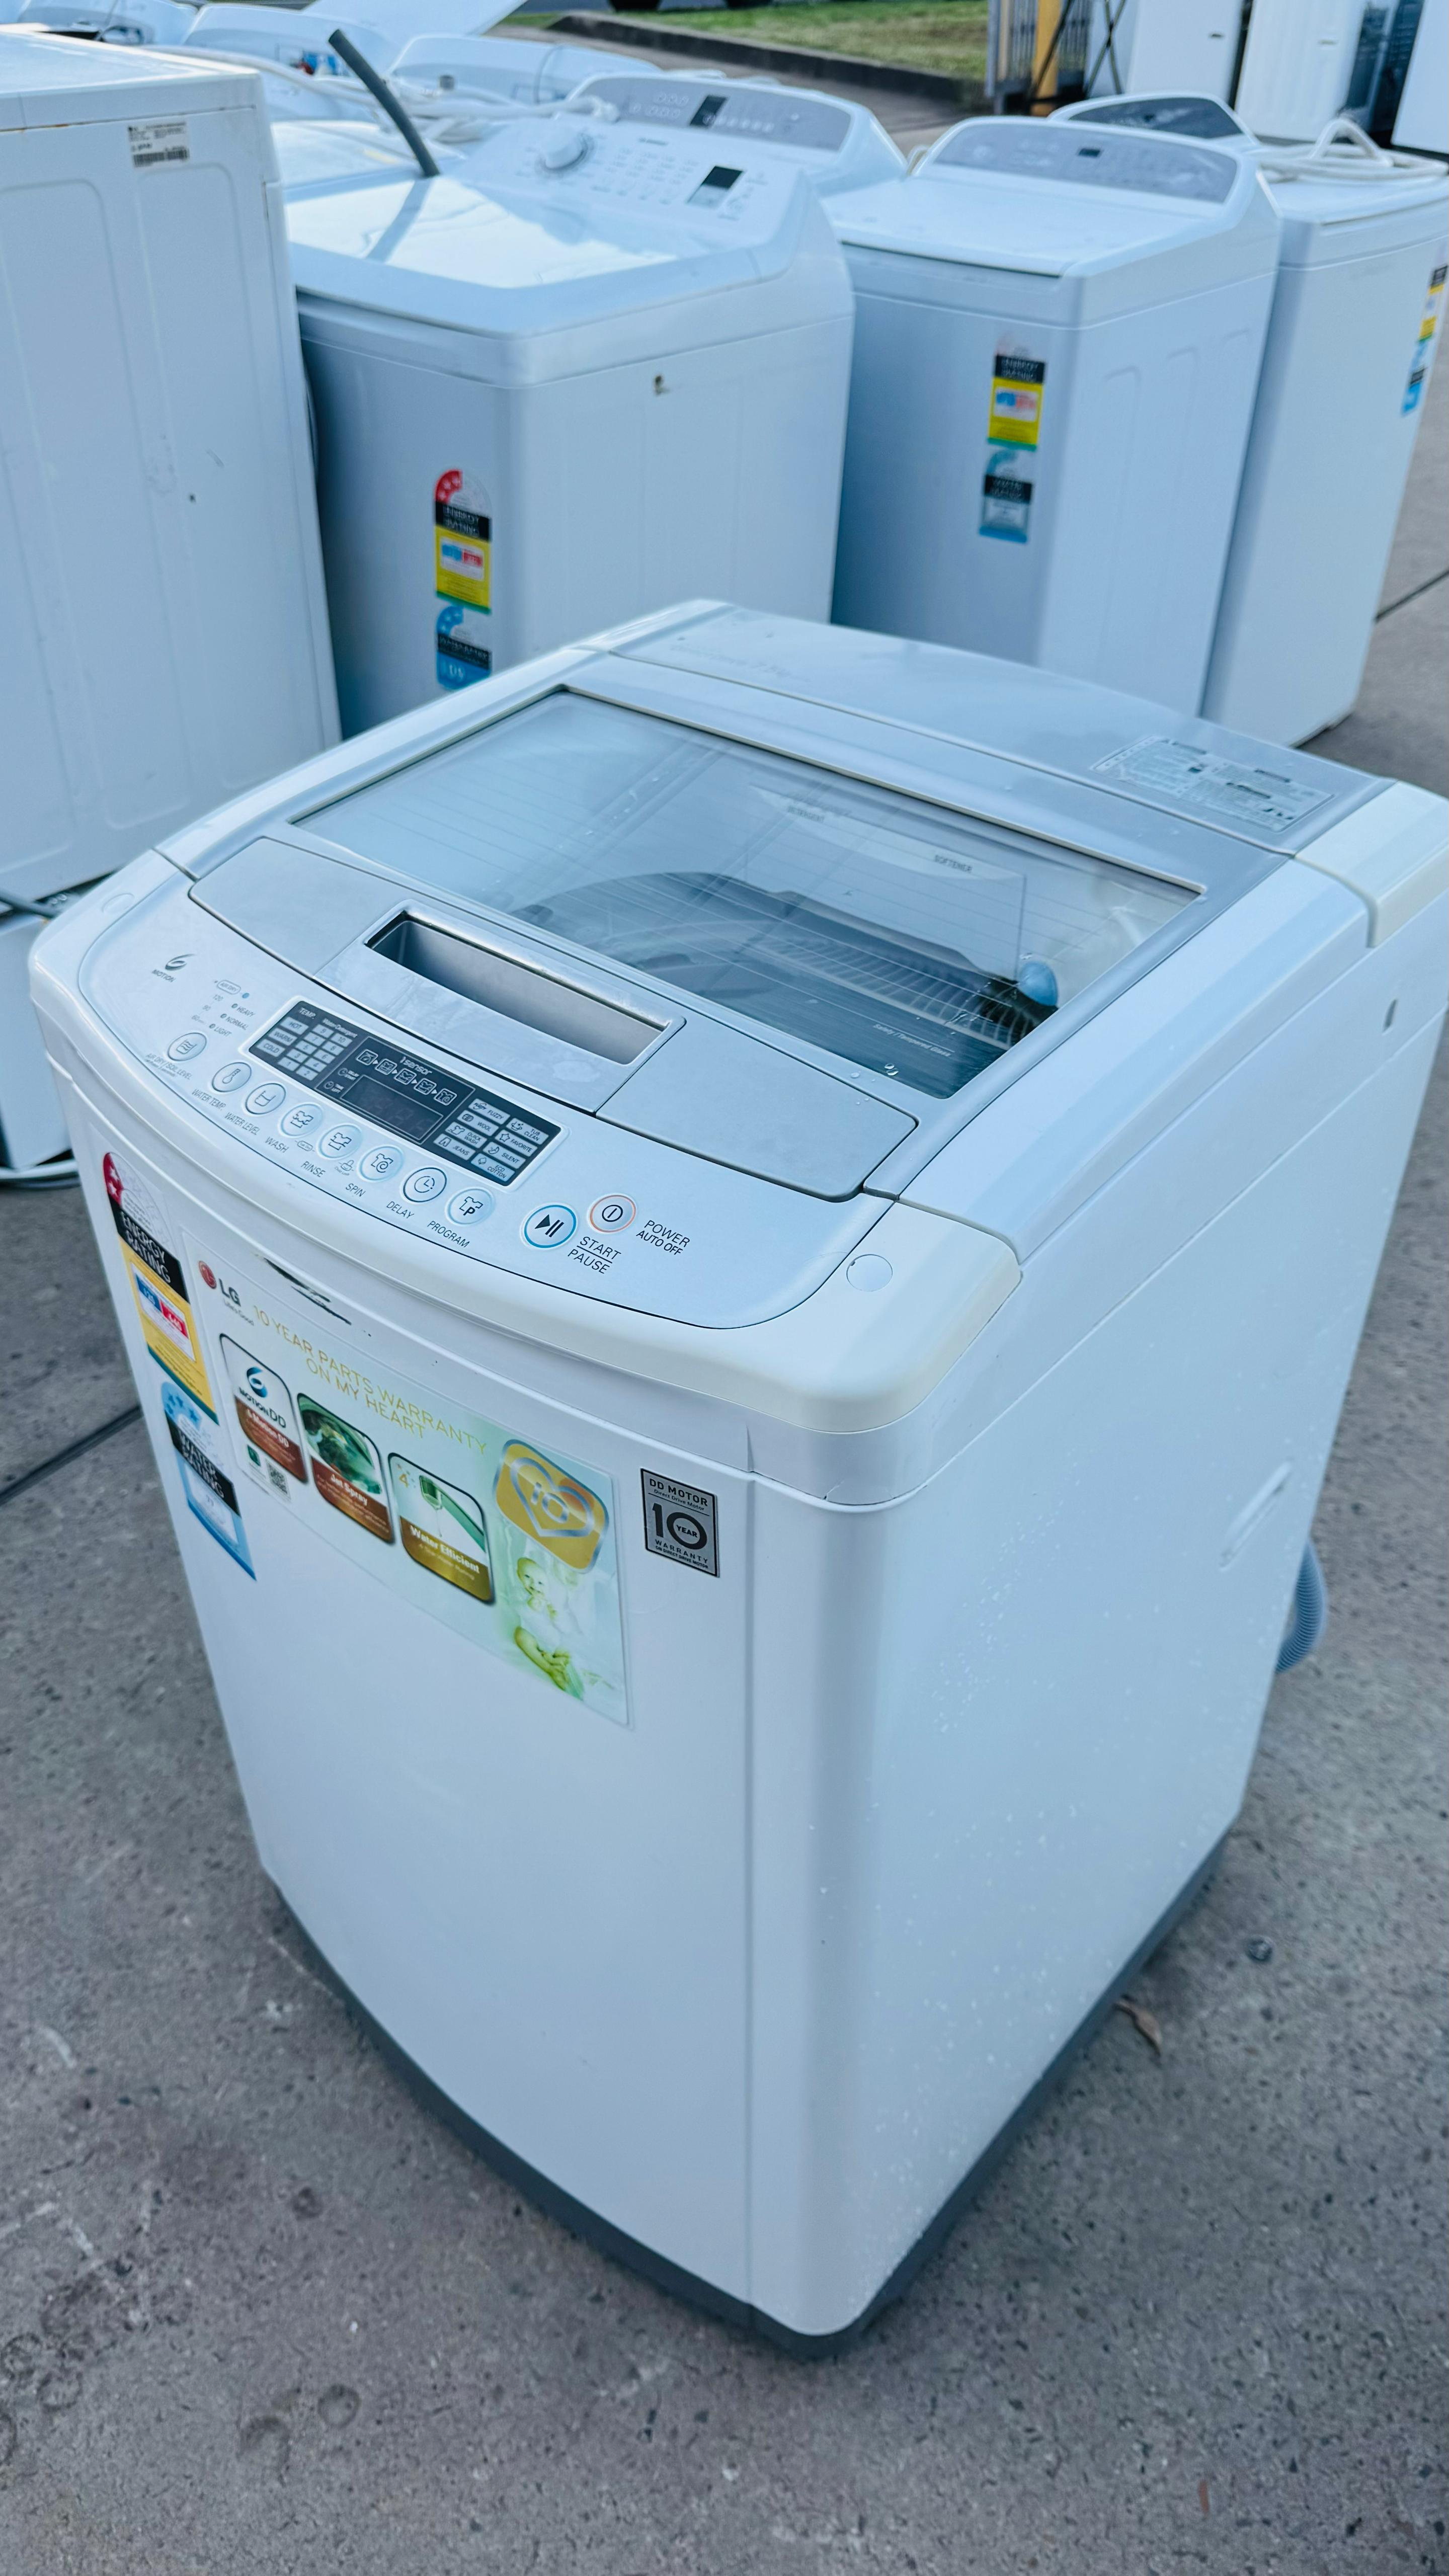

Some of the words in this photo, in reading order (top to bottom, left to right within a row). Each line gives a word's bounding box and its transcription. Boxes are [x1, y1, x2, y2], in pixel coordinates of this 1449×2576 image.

[934, 854, 973, 873] SOFTENER
[152, 970, 176, 982] MOTION
[236, 1007, 255, 1017] HEAVY
[299, 1007, 316, 1019] TEMP.
[225, 1016, 249, 1030] NORMAL
[289, 1021, 302, 1030] HOT
[214, 1026, 232, 1037] LIGHT
[274, 1030, 293, 1042] WARM
[264, 1043, 280, 1053] COLD
[192, 1088, 211, 1102] WATER
[209, 1098, 226, 1110] TEMP.
[488, 1110, 504, 1120] FUZZY
[225, 1112, 245, 1126] WATER
[243, 1121, 260, 1135] LEVEL
[477, 1121, 491, 1132] WOOL
[464, 1135, 478, 1145] WASH
[467, 1132, 481, 1142] QUICK
[524, 1131, 540, 1142] CLEAN
[265, 1137, 289, 1153] WASH
[453, 1145, 470, 1156] JEANS
[510, 1139, 532, 1153] FAVORITE
[502, 1153, 520, 1164] SILENT
[301, 1161, 326, 1177] RINSE
[487, 1166, 507, 1179] COTTON
[346, 1183, 366, 1197] SPIN
[386, 1201, 414, 1219] DELAY
[121, 1211, 165, 1263] ENERGY
[427, 1221, 470, 1248] PROGRAM
[644, 1220, 690, 1247] POWER
[580, 1236, 622, 1260] START
[636, 1230, 664, 1247] AUTO
[664, 1243, 683, 1255] OFF
[126, 1231, 171, 1283] RATING
[568, 1249, 610, 1274] PAUSE
[219, 1278, 241, 1307] LG
[254, 1305, 270, 1326] 10
[272, 1318, 313, 1357] YEAR
[318, 1349, 374, 1394] PARTS
[377, 1385, 487, 1454] WARRANTY
[306, 1358, 331, 1384] ON
[336, 1376, 359, 1400] MY
[366, 1394, 426, 1438] HEART
[277, 1433, 289, 1448] DD
[331, 1474, 344, 1488] Jet
[344, 1482, 368, 1506] Spray
[650, 1478, 664, 1489] DD
[668, 1485, 708, 1506] MOTOR
[654, 1489, 670, 1498] Direct
[672, 1494, 686, 1504] Drive
[687, 1501, 704, 1511] Motor
[652, 1503, 707, 1550] 10
[676, 1525, 698, 1538] YEAR
[410, 1524, 438, 1549] Water
[440, 1541, 480, 1574] Efficient
[655, 1539, 708, 1563] WARRANTY
[663, 1549, 678, 1557] DIRECT
[679, 1555, 691, 1563] DRIVE
[692, 1560, 708, 1569] MOTOR
